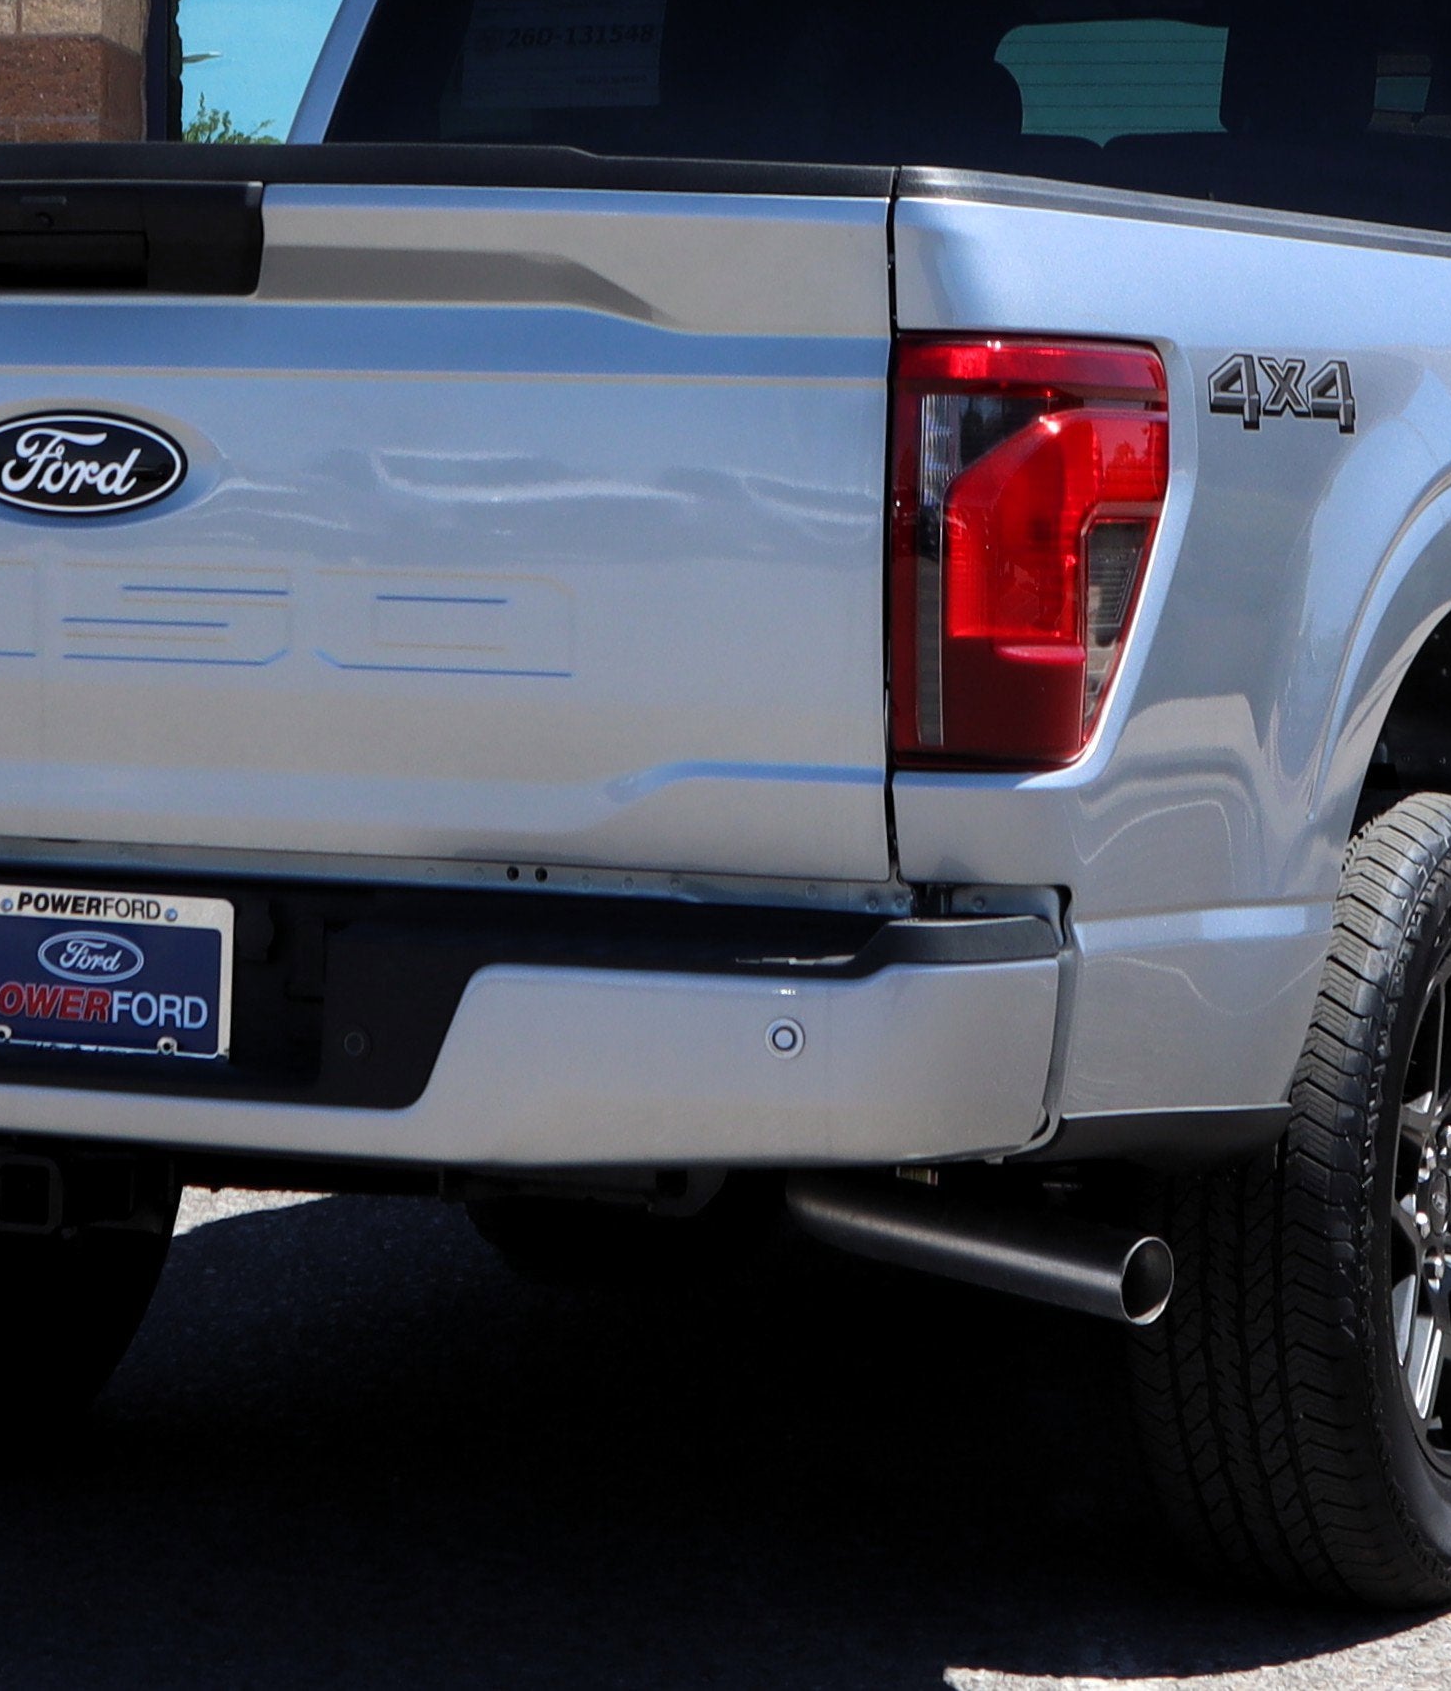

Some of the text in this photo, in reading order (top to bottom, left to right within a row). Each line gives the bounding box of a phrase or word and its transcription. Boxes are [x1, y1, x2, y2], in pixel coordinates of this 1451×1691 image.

[0, 426, 142, 498] Ford
[16, 892, 162, 921] POWERFORD
[58, 939, 124, 974] Ford
